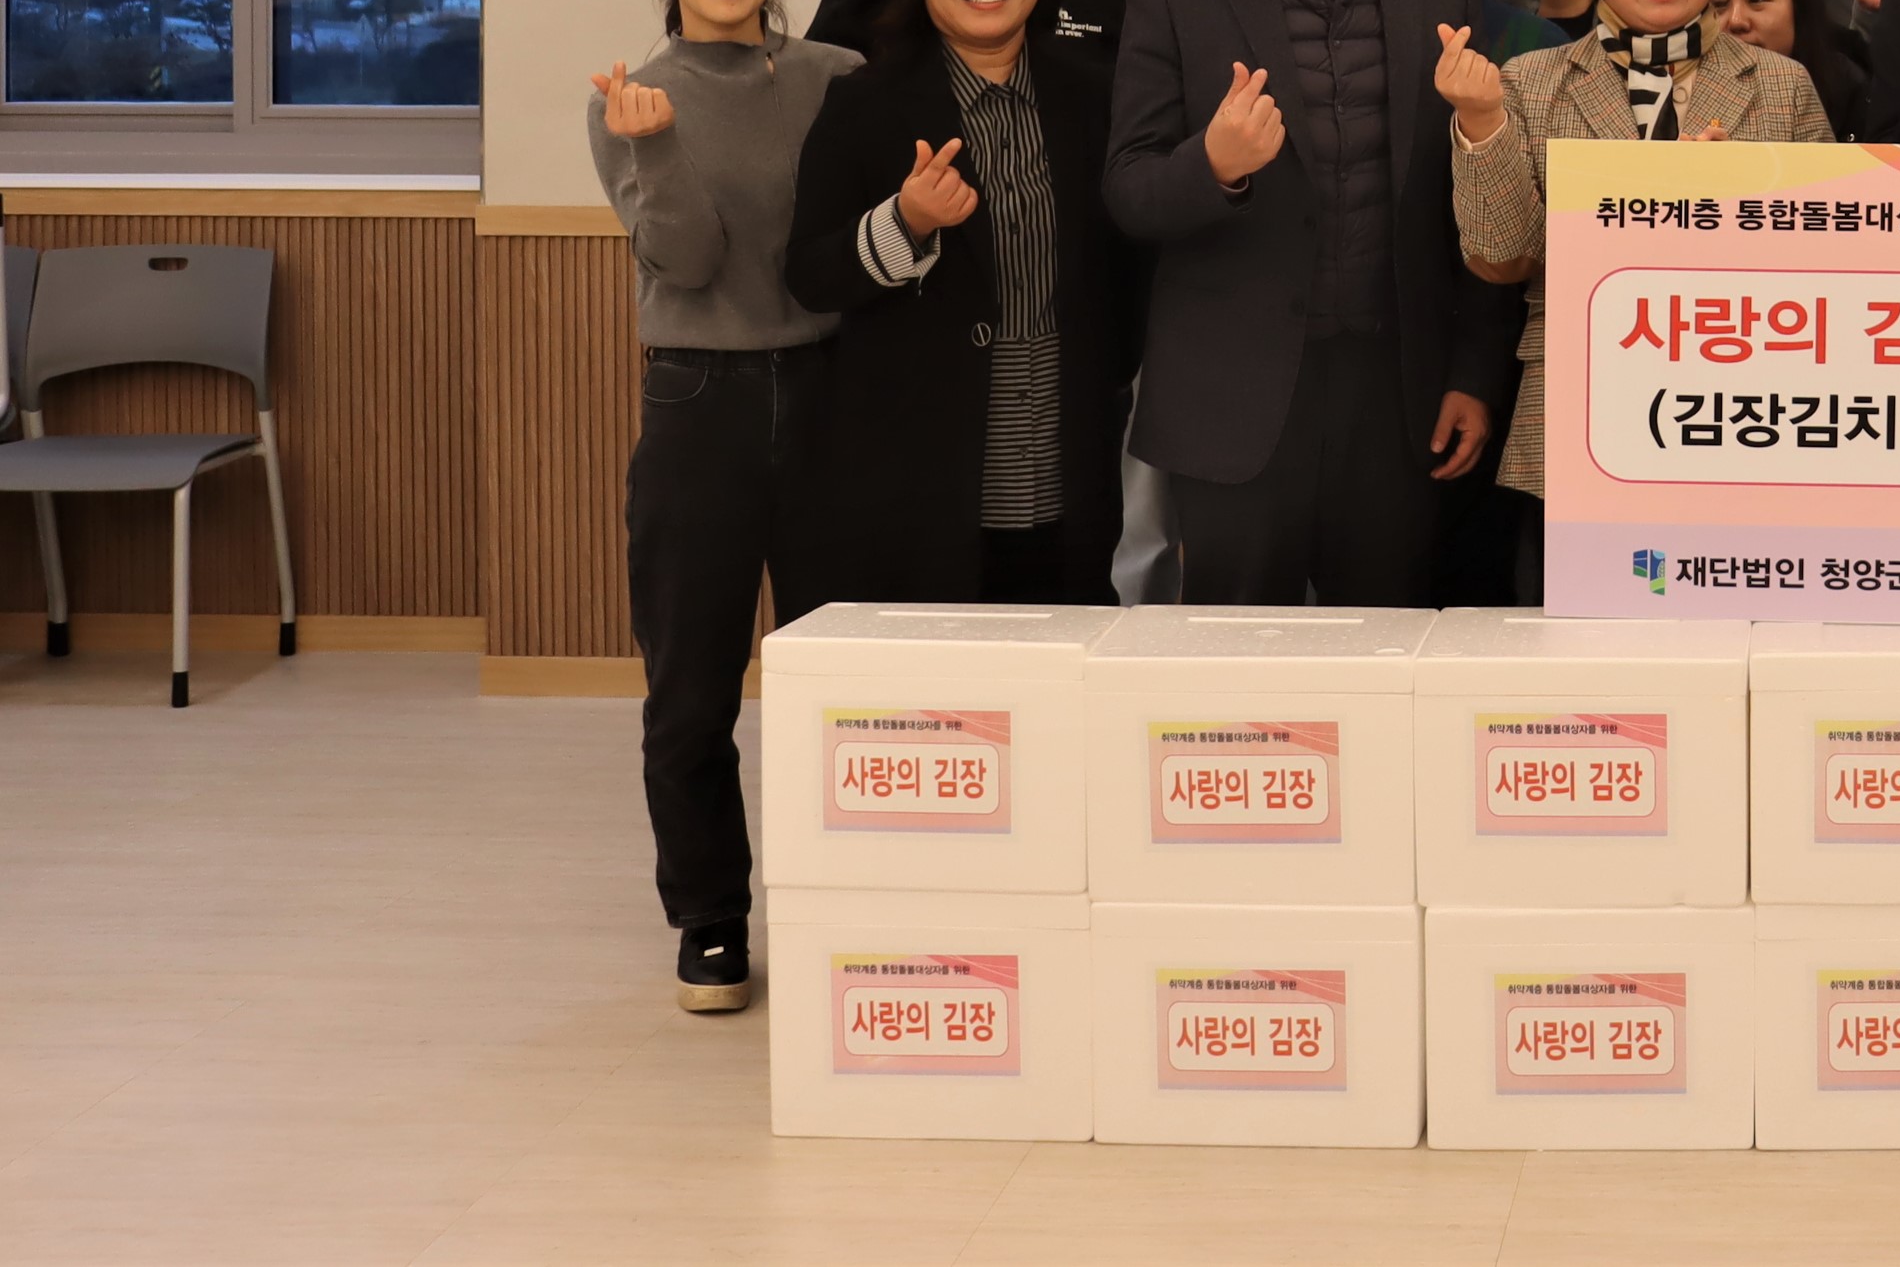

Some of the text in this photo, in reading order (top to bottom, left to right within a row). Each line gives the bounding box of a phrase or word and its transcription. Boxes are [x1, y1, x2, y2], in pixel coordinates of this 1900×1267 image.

[1597, 198, 1722, 230] 취약계층
[1619, 295, 1826, 364] 사랑의
[1649, 389, 1896, 449] (김장김치
[1676, 557, 1804, 588] 재단법인
[843, 756, 986, 799] 사랑의 김장
[1170, 769, 1315, 809] 사랑의 김장
[1495, 761, 1642, 802] 사랑의 김장
[852, 1001, 995, 1042] 사랑의 김장
[1177, 1016, 1322, 1057] 사랑의 김장
[1515, 1020, 1662, 1061] 사랑의 김장
